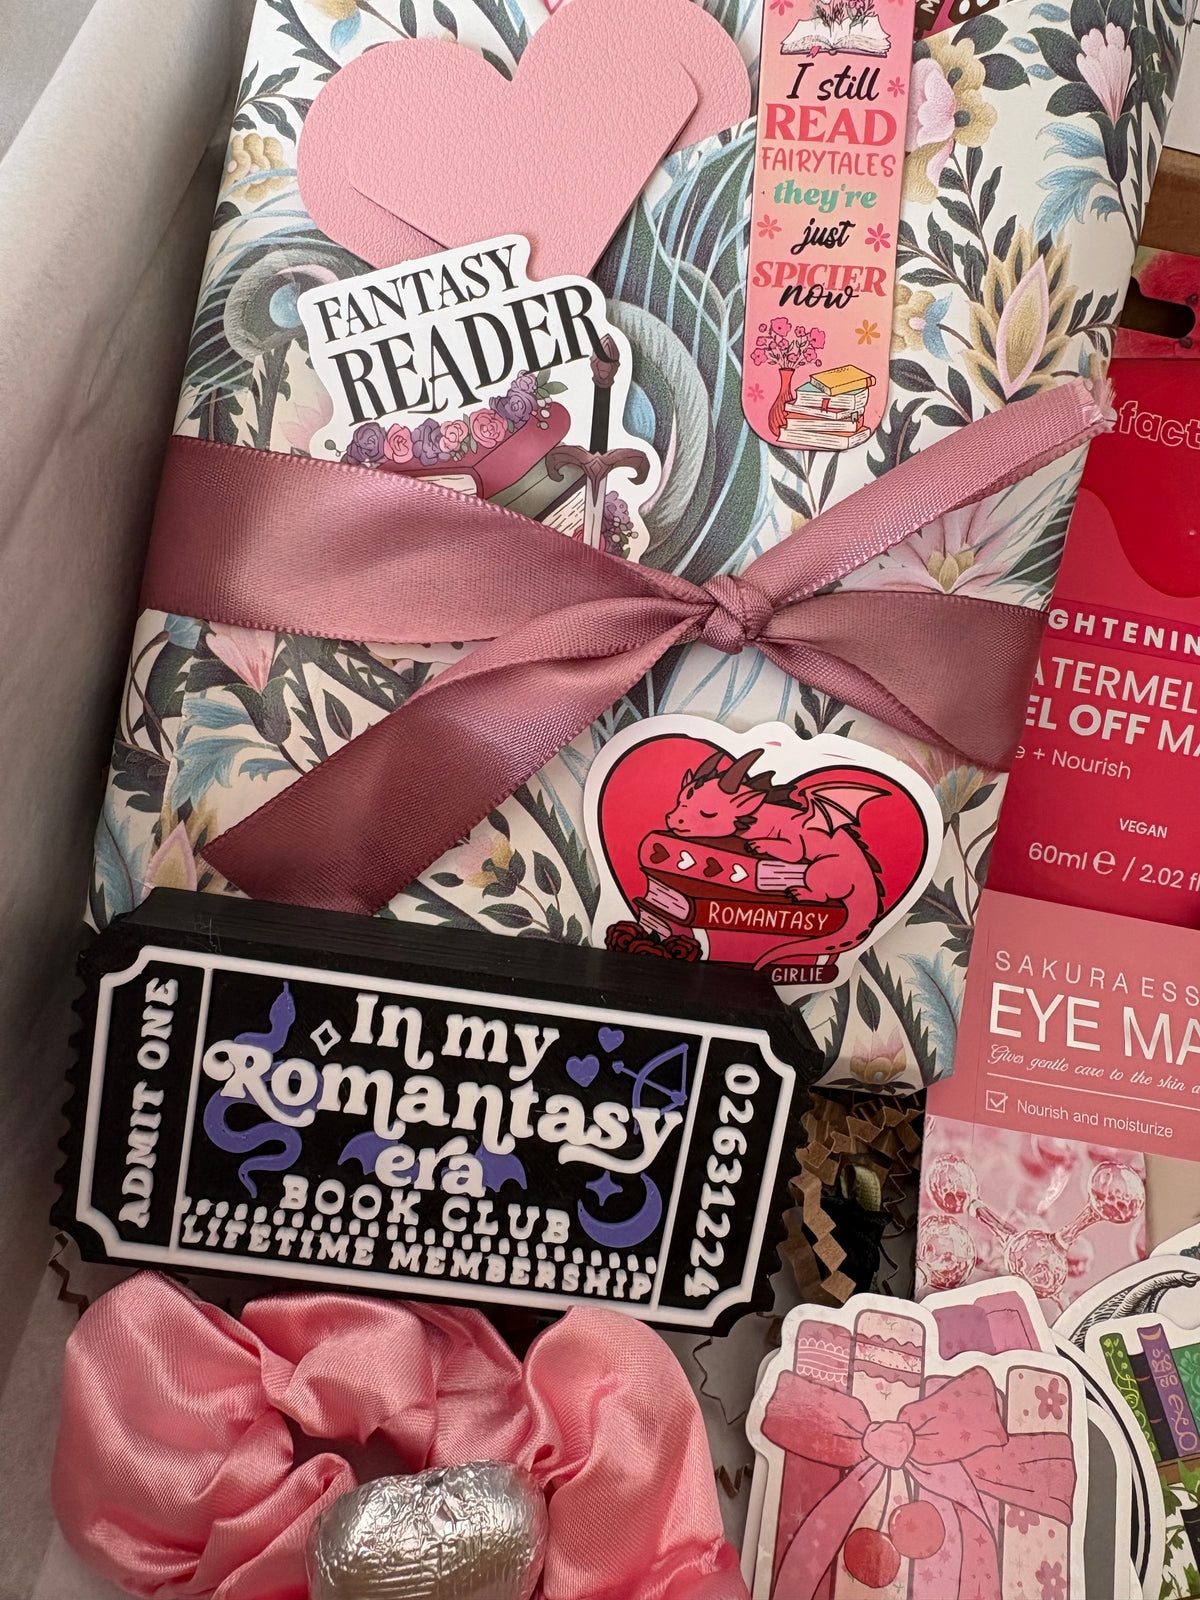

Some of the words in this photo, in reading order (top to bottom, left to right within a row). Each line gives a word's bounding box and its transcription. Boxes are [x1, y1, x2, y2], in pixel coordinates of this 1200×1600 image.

[786, 62, 814, 100] I
[818, 65, 881, 101] still
[762, 103, 897, 147] READ
[762, 147, 896, 178] FAIRYTALES
[773, 179, 878, 214] they're
[791, 219, 856, 255] just
[313, 244, 520, 344] FANTASY
[752, 261, 887, 296] SPICIER
[779, 282, 860, 310] now
[328, 284, 620, 427] READER
[1069, 704, 1150, 745] OFF
[1158, 719, 1200, 757] M
[1052, 749, 1131, 780] Nourish
[1119, 818, 1168, 838] VEGAN
[1028, 842, 1087, 870] 60ml
[1139, 864, 1184, 889] 2.02
[708, 901, 829, 931] ROMANTASY
[771, 967, 824, 983] GIRLIE
[995, 950, 1128, 994] SAKURA
[137, 977, 178, 1070] ONE
[350, 992, 434, 1070] In
[441, 1013, 560, 1082] my
[989, 982, 1100, 1052] EYE
[1026, 1055, 1069, 1072] gentle
[1074, 1064, 1104, 1078] care
[1109, 1065, 1124, 1080] to
[1130, 1070, 1152, 1086] the
[1156, 1075, 1186, 1092] skin
[203, 1039, 683, 1174] Romantasy
[1017, 1099, 1069, 1120] Nourish
[1073, 1107, 1099, 1126] and
[1103, 1116, 1173, 1138] moisturize
[118, 1079, 164, 1228] ADMIT
[375, 1136, 487, 1198] era
[684, 1063, 760, 1298] 02631224
[279, 1174, 422, 1226] BOOK
[442, 1196, 571, 1244] CLUB
[181, 1214, 375, 1266] LIFETIME
[389, 1241, 653, 1300] MEMBERSHIP
